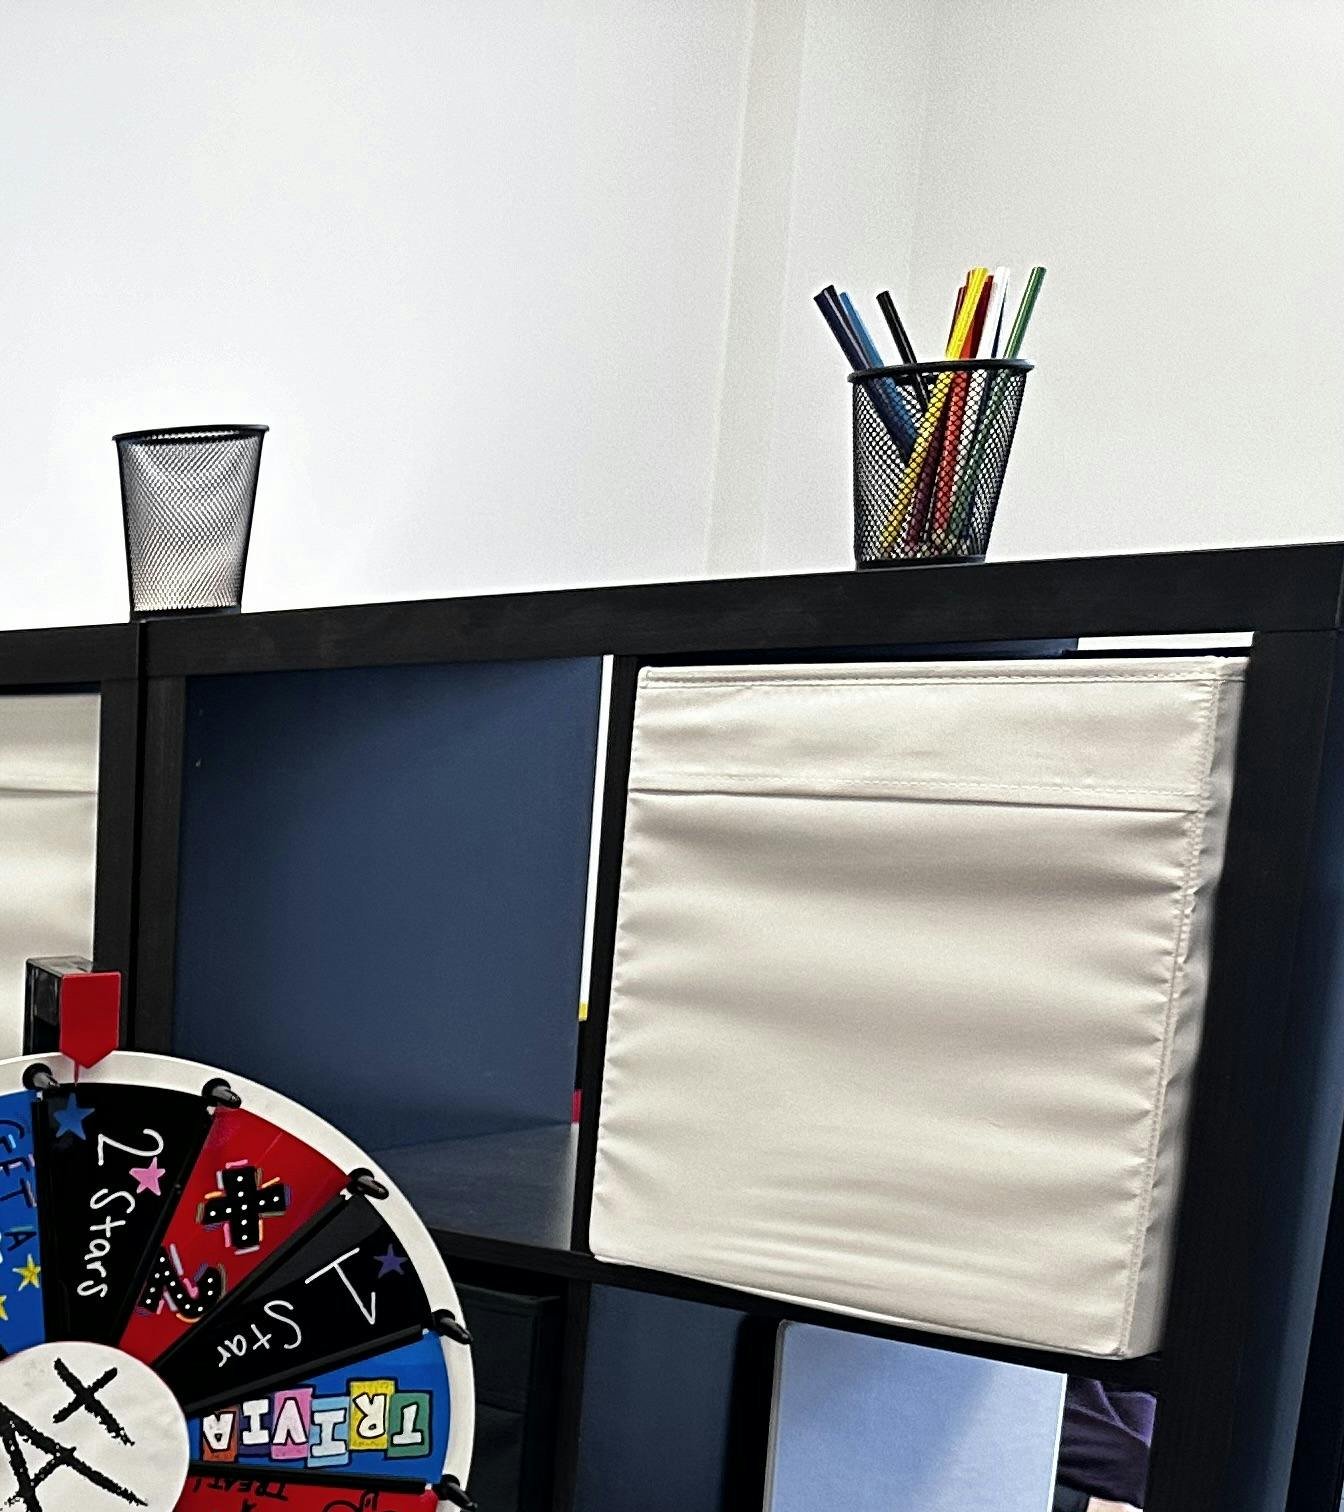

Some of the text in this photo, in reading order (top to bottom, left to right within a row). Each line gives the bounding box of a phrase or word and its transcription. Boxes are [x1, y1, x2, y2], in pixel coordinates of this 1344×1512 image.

[3, 1227, 37, 1251] A
[77, 1128, 164, 1297] 2 Stars
[218, 1247, 377, 1368] 1 Star
[202, 1392, 423, 1459] TRIVIA
